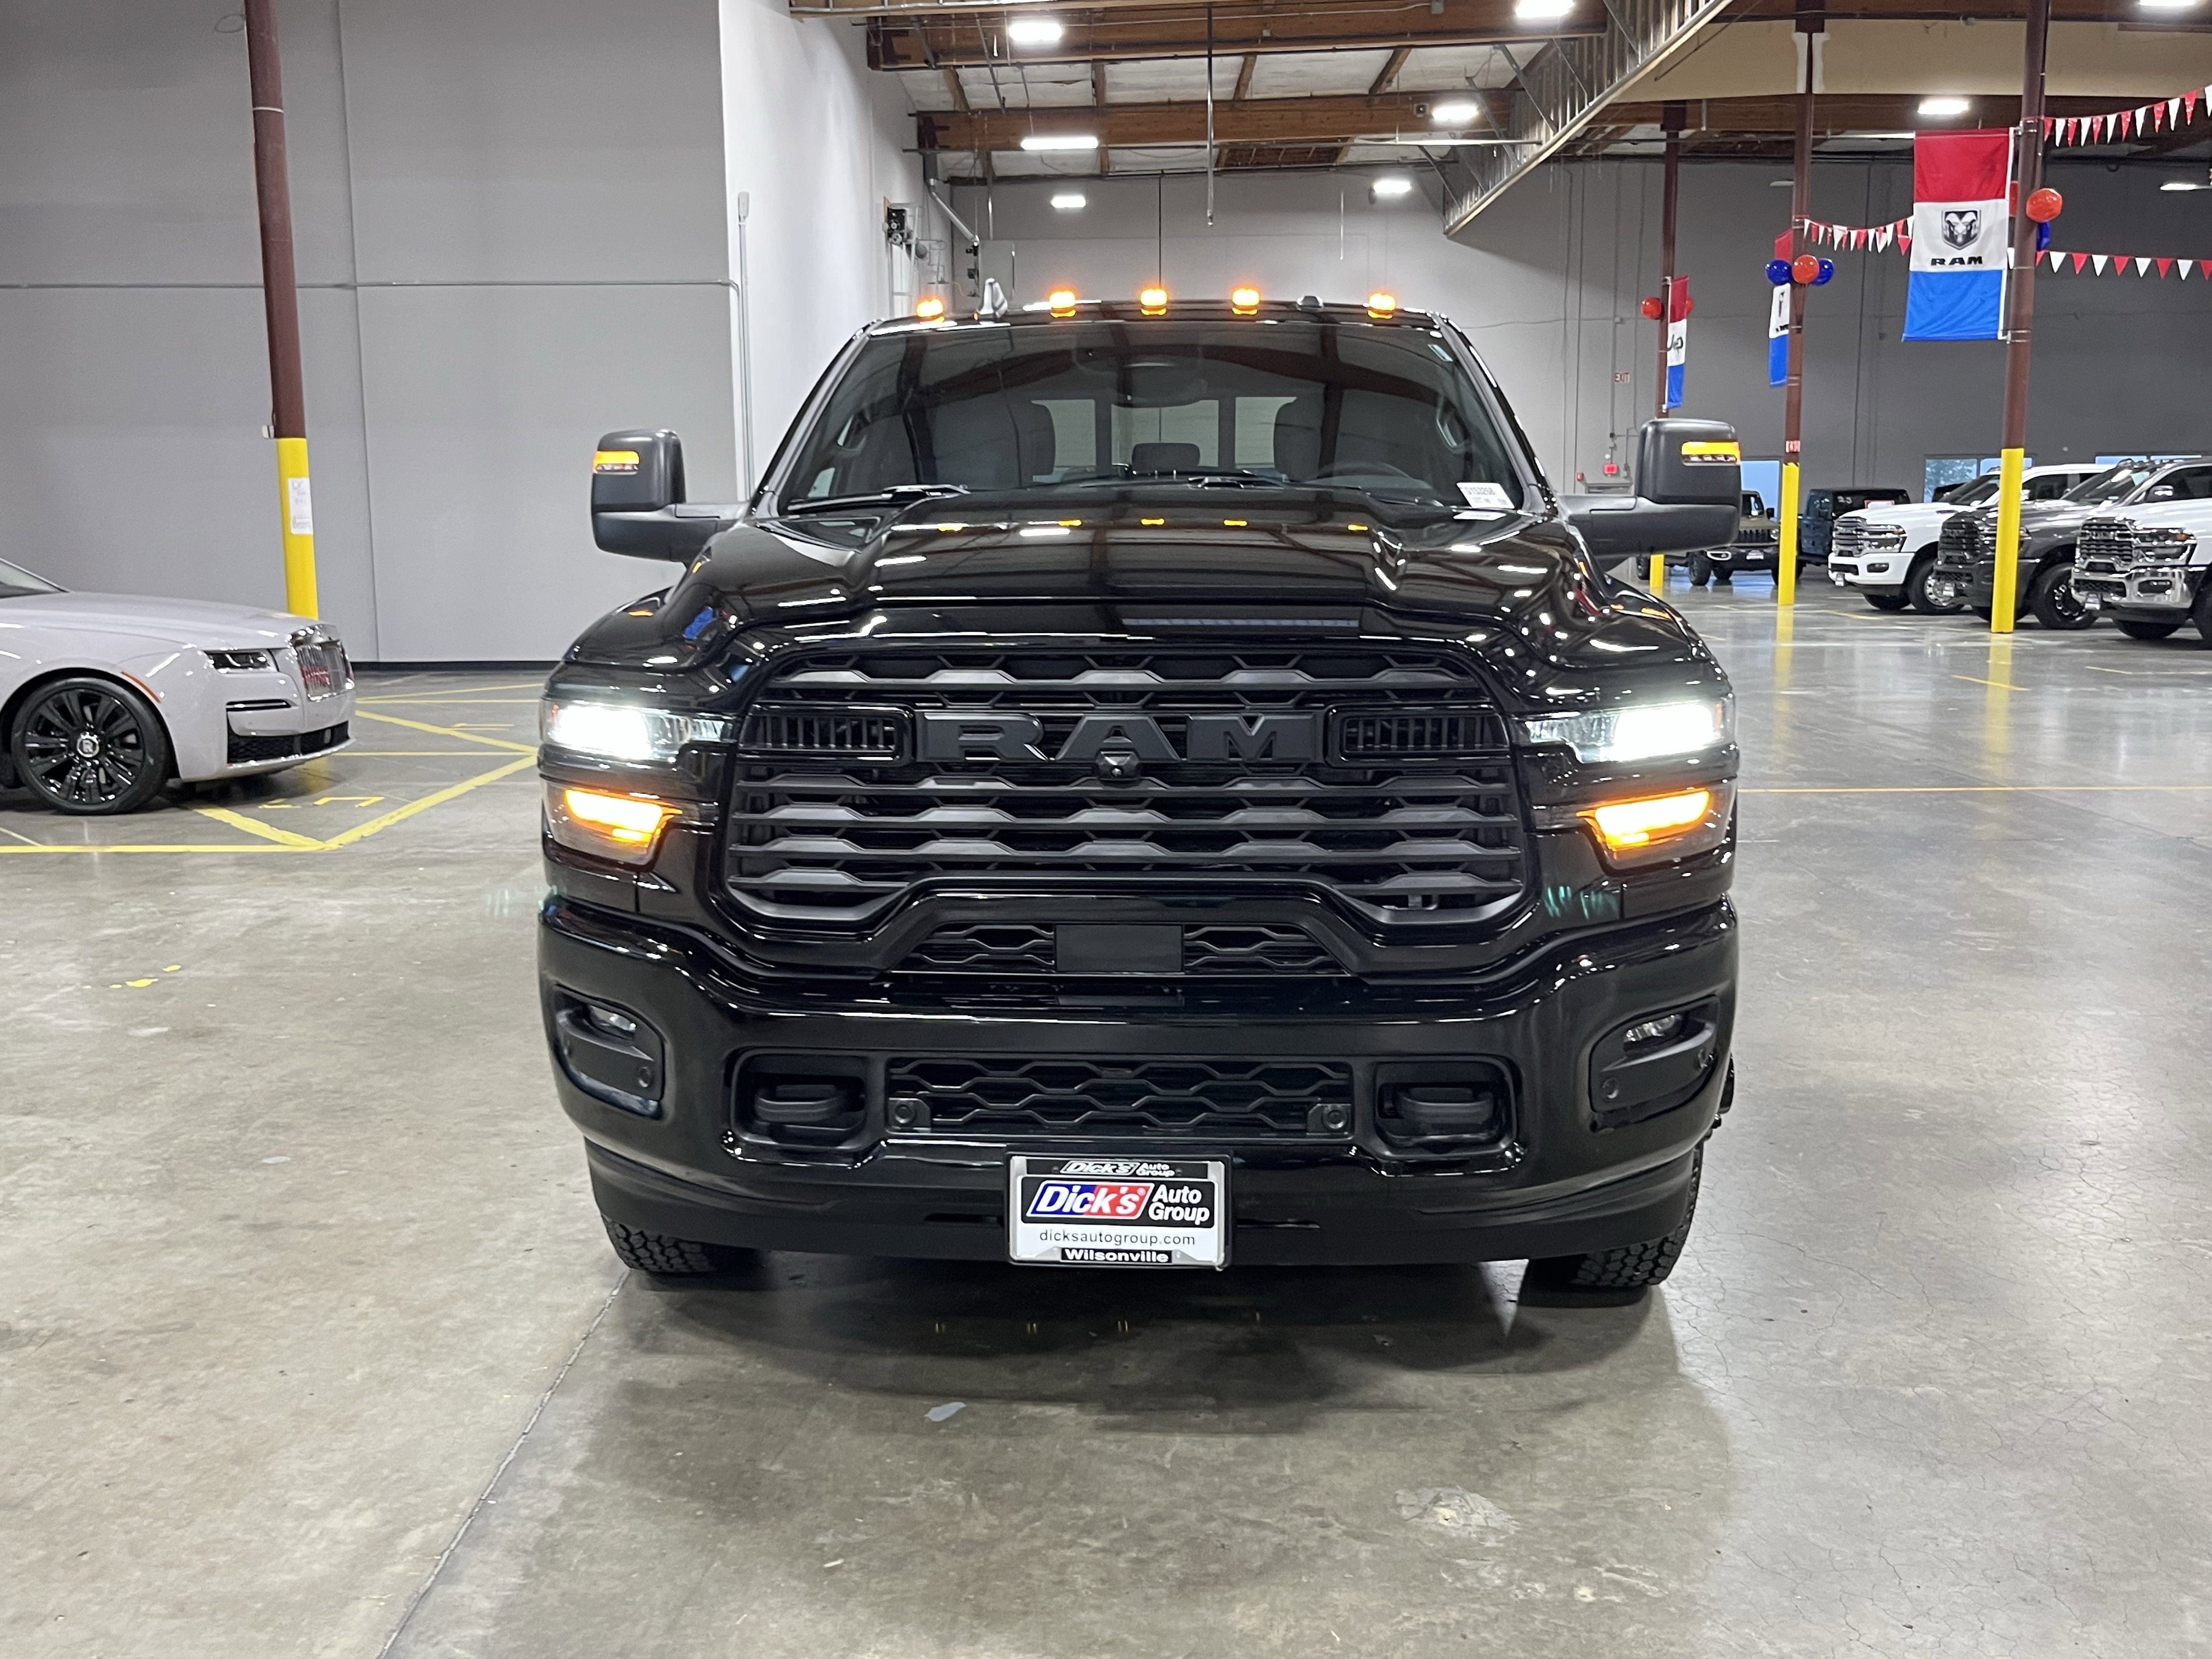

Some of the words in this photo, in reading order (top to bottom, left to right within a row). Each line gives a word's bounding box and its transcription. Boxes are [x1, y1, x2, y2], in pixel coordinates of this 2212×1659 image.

[1931, 256, 1983, 266] RAM
[914, 713, 1319, 763] RAM
[1066, 1162, 1131, 1173] Dick's
[1138, 1163, 1170, 1171] Auto
[1136, 1169, 1175, 1177] Group
[1036, 1186, 1141, 1215] Dick's
[1153, 1184, 1202, 1204] Auto
[1148, 1202, 1210, 1225] Group
[1039, 1229, 1195, 1246] dicksautogroup.com
[1064, 1249, 1169, 1262] Wilsonville
